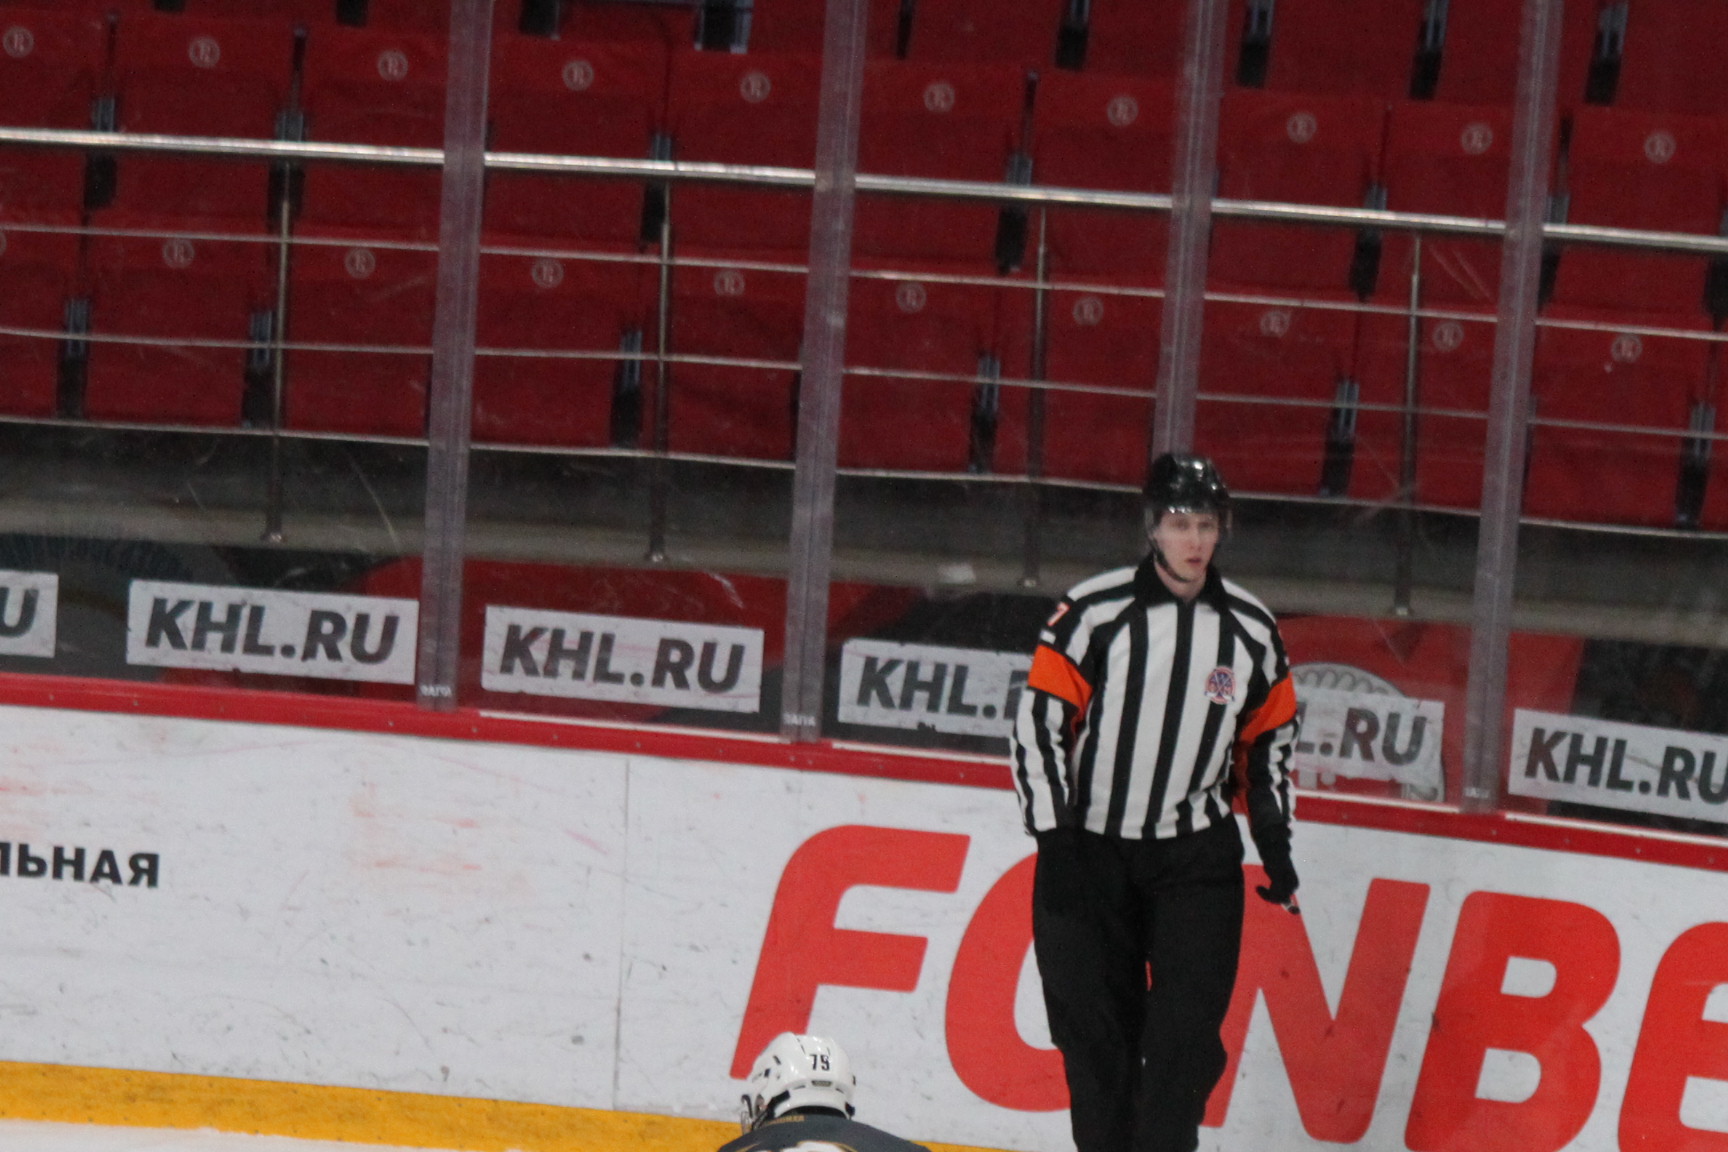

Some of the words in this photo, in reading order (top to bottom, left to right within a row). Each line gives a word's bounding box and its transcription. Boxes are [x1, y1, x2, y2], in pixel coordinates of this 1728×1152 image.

[146, 597, 399, 665] KHL.RU
[500, 624, 746, 693] KHL.RU
[857, 656, 1029, 721] KHL.
[1294, 701, 1428, 766] L.RU
